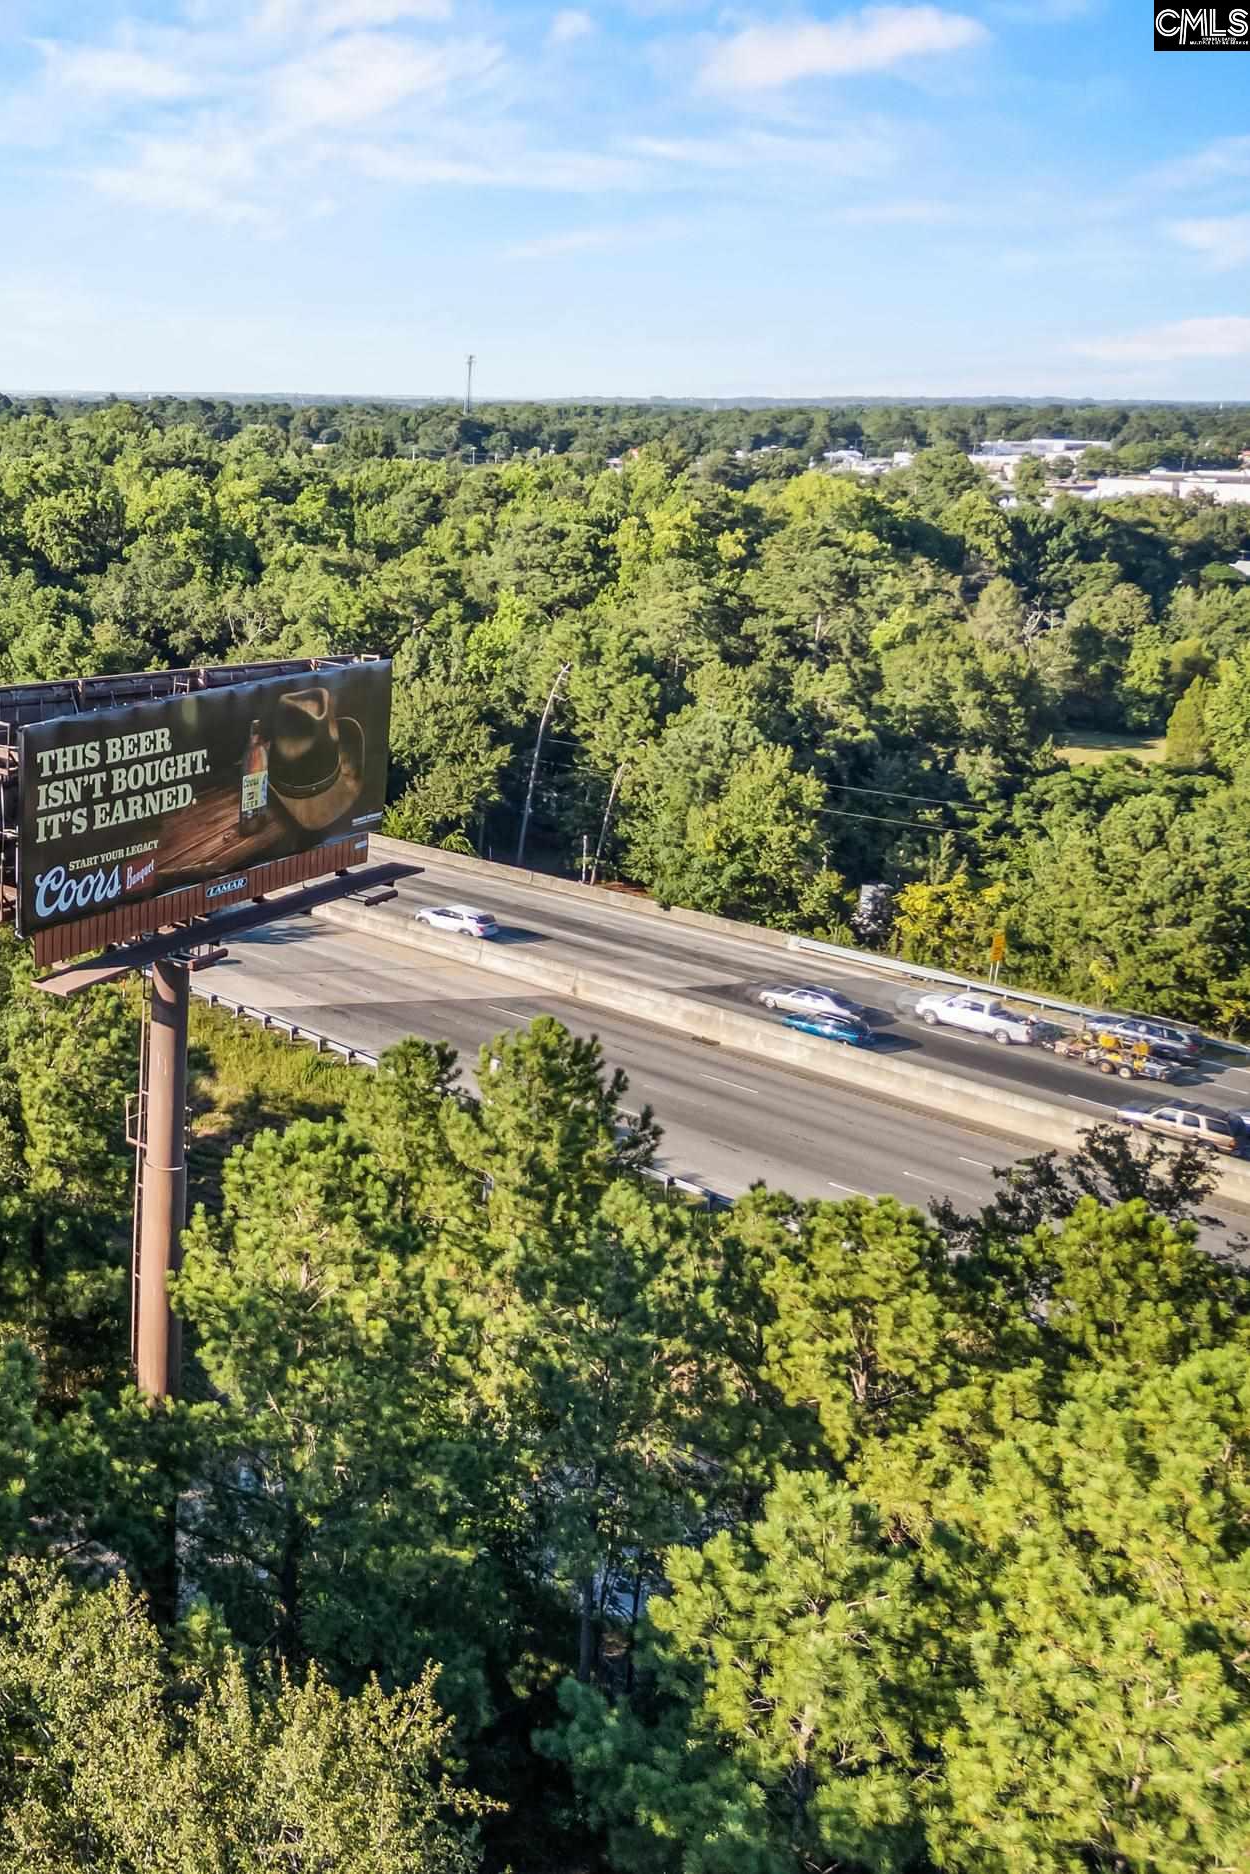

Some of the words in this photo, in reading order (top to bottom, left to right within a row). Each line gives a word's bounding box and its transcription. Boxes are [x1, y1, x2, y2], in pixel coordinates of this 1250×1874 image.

[36, 741, 100, 777] THIS
[105, 727, 172, 764] BEER
[36, 771, 107, 811] ISN'T
[111, 749, 211, 795] BOUGHT.
[35, 807, 88, 844] IT'S
[92, 783, 197, 830] EARNED.
[68, 856, 99, 872] START
[99, 848, 125, 864] YOUR
[125, 840, 159, 857] LEGACY
[34, 864, 122, 918] Coors
[209, 878, 245, 896] LAMAR
